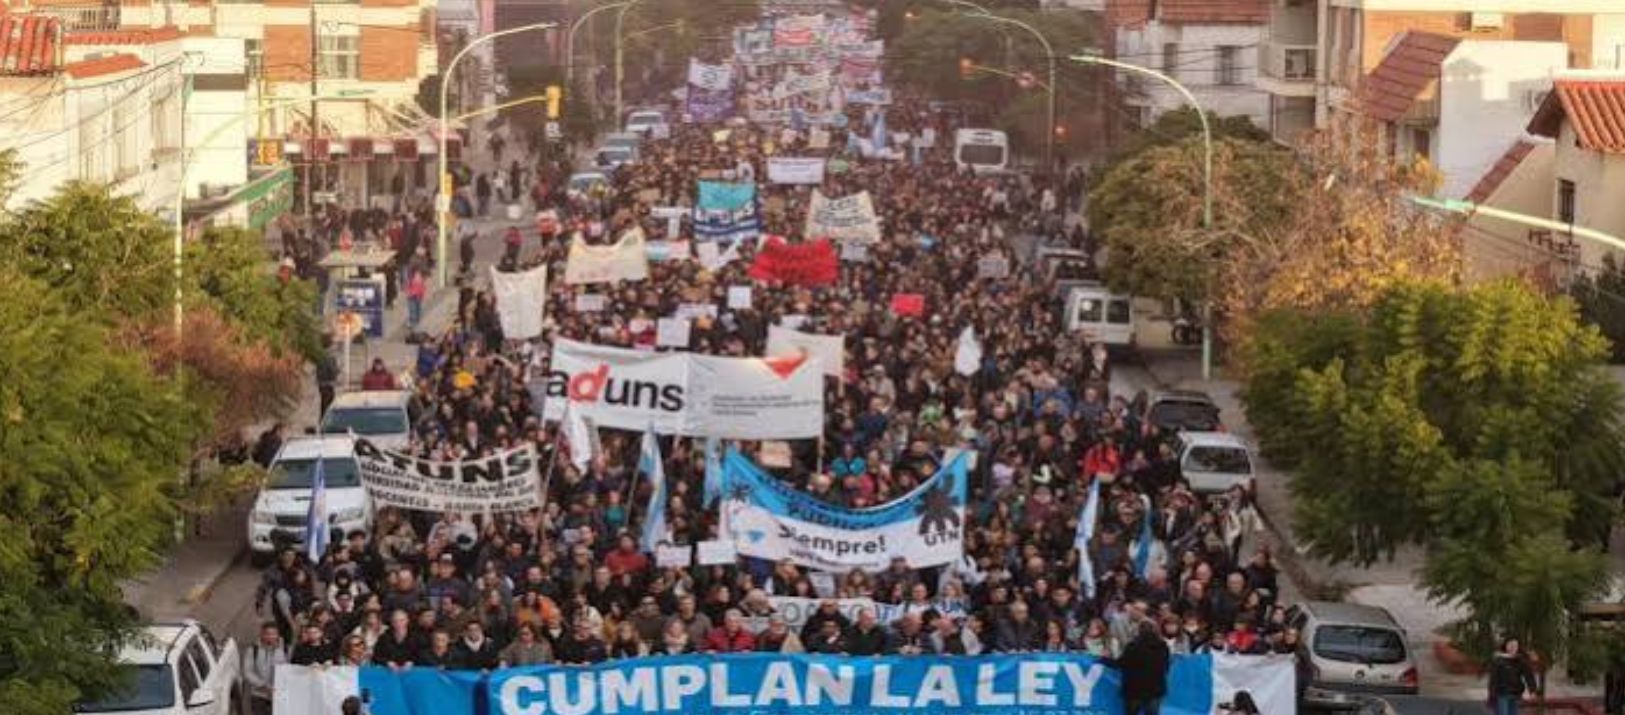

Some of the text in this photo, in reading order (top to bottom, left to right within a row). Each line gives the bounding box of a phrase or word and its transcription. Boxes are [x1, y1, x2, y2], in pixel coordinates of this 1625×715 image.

[547, 363, 685, 412] aduns
[354, 438, 532, 483] ATUNS
[923, 530, 960, 547] UTN
[500, 660, 1104, 715] CUMPLAN LA LEY
